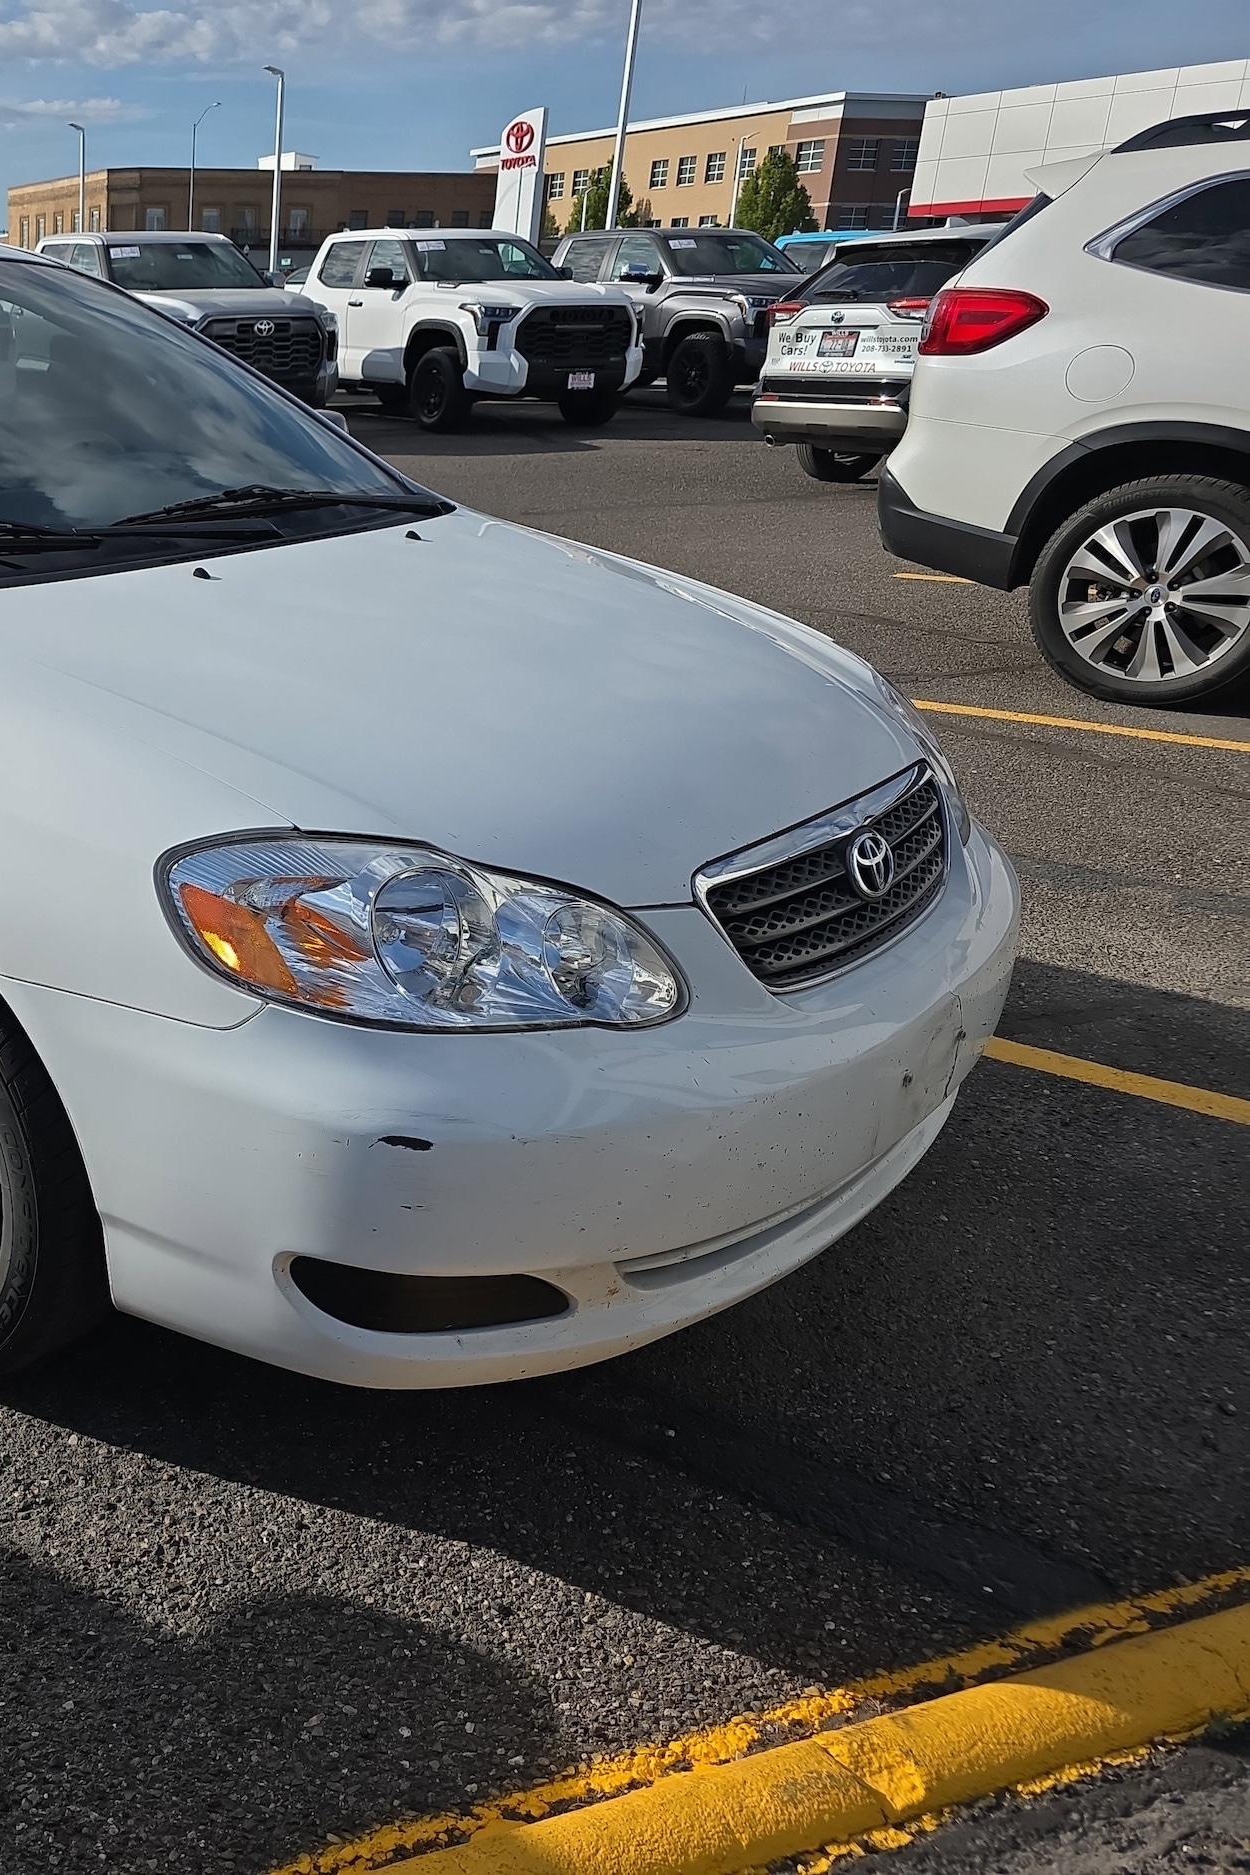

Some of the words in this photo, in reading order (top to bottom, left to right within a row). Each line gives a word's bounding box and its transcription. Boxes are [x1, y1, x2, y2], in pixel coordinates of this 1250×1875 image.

[500, 155, 537, 171] TOYOTA
[778, 332, 791, 343] We
[795, 332, 817, 346] Buy
[860, 335, 918, 344] willstoyota.com
[781, 345, 808, 356] Cars!
[789, 361, 819, 372] WILLS
[835, 362, 876, 373] TOYOTA
[1102, 488, 1185, 512] BRIDGESTONE
[0, 1123, 33, 1325] CONFIDENCE
